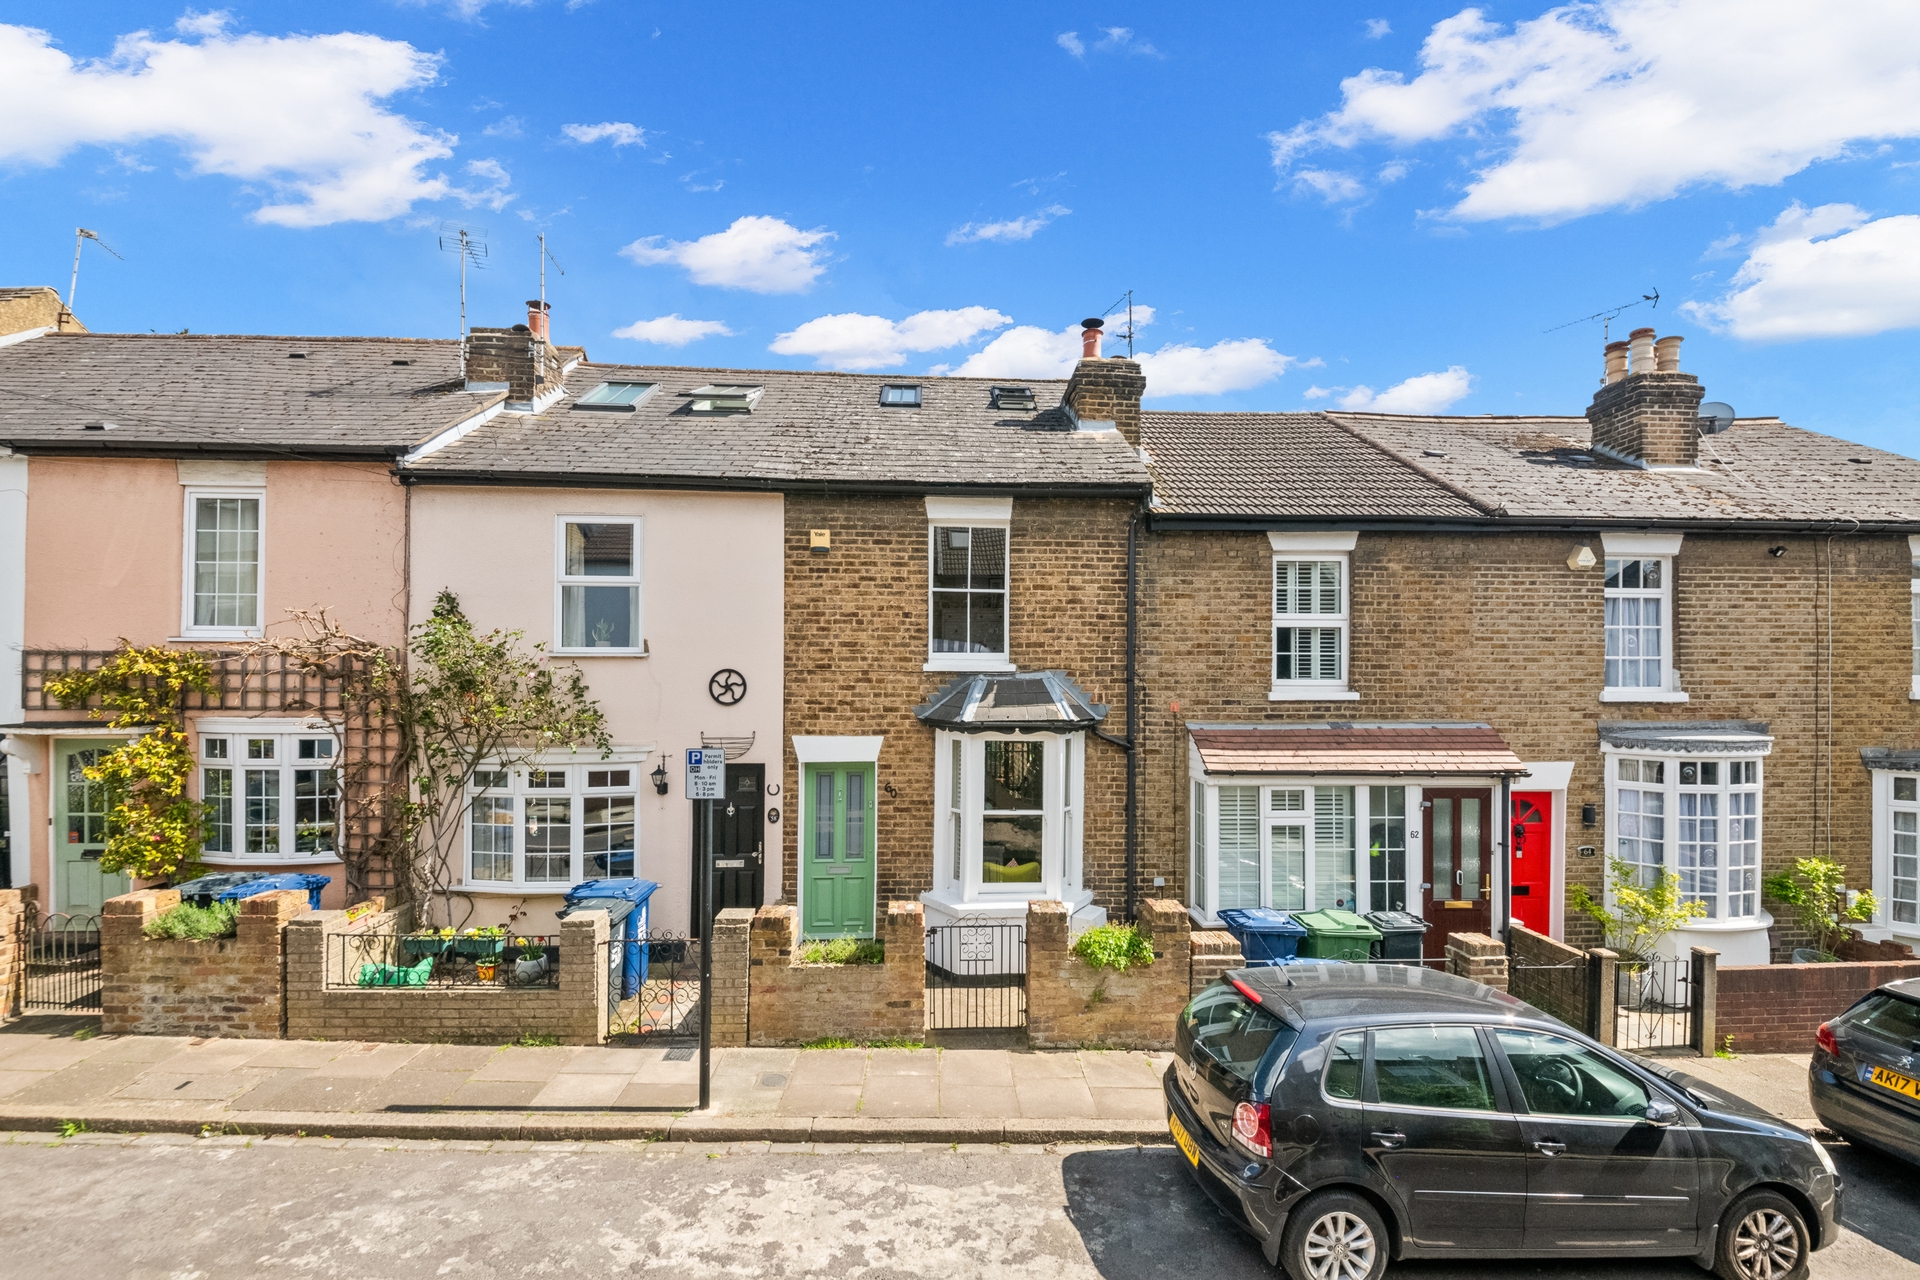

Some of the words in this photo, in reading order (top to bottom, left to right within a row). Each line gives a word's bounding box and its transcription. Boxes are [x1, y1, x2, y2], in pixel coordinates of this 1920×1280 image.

[691, 752, 701, 764] P
[884, 782, 898, 799] 60
[1410, 830, 1420, 839] 62
[1874, 1069, 1911, 1090] AK17
